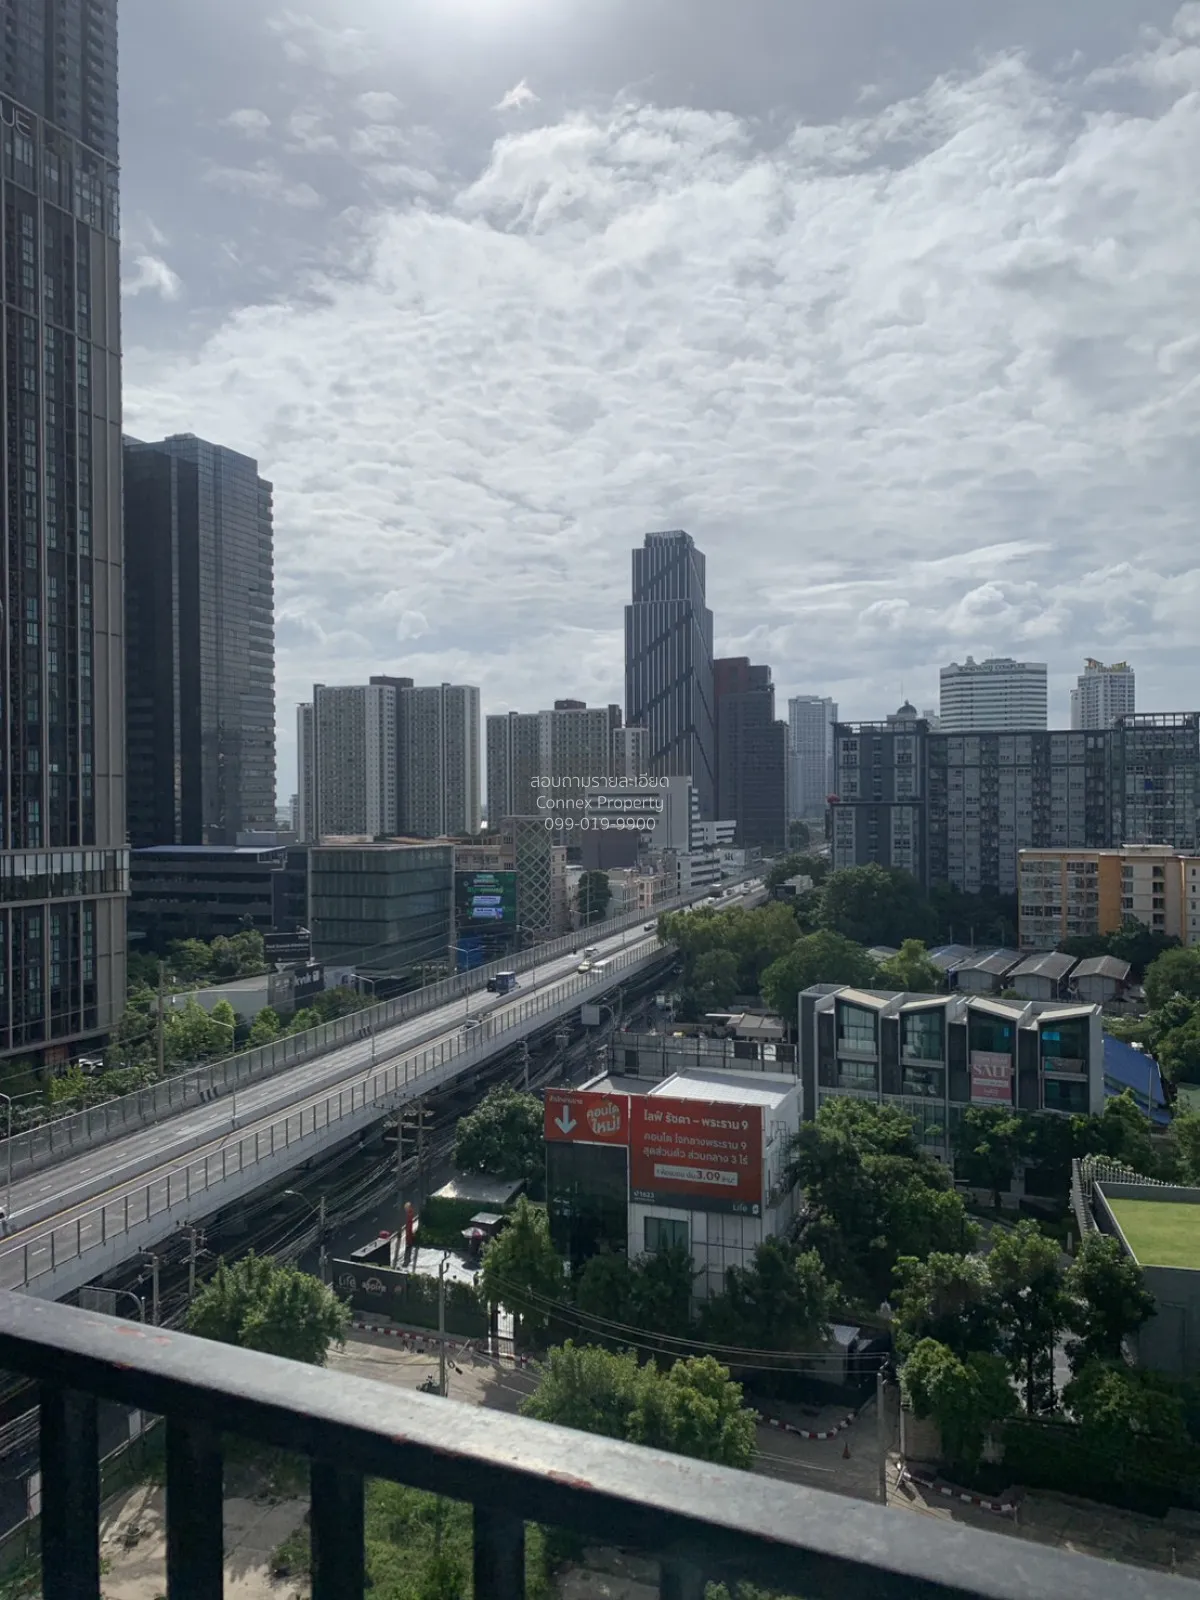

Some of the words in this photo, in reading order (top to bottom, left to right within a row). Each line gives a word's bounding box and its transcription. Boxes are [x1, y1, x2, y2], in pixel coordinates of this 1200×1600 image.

[586, 1101, 620, 1118] คอนโด
[665, 1111, 691, 1125] รัชดา
[701, 1118, 740, 1130] พระราม
[741, 1120, 748, 1130] 9
[643, 1131, 672, 1144] คอนโด
[740, 1141, 748, 1151] 9
[731, 1155, 738, 1164] 3
[696, 1170, 721, 1181] 3.09
[338, 1274, 356, 1288] Life
